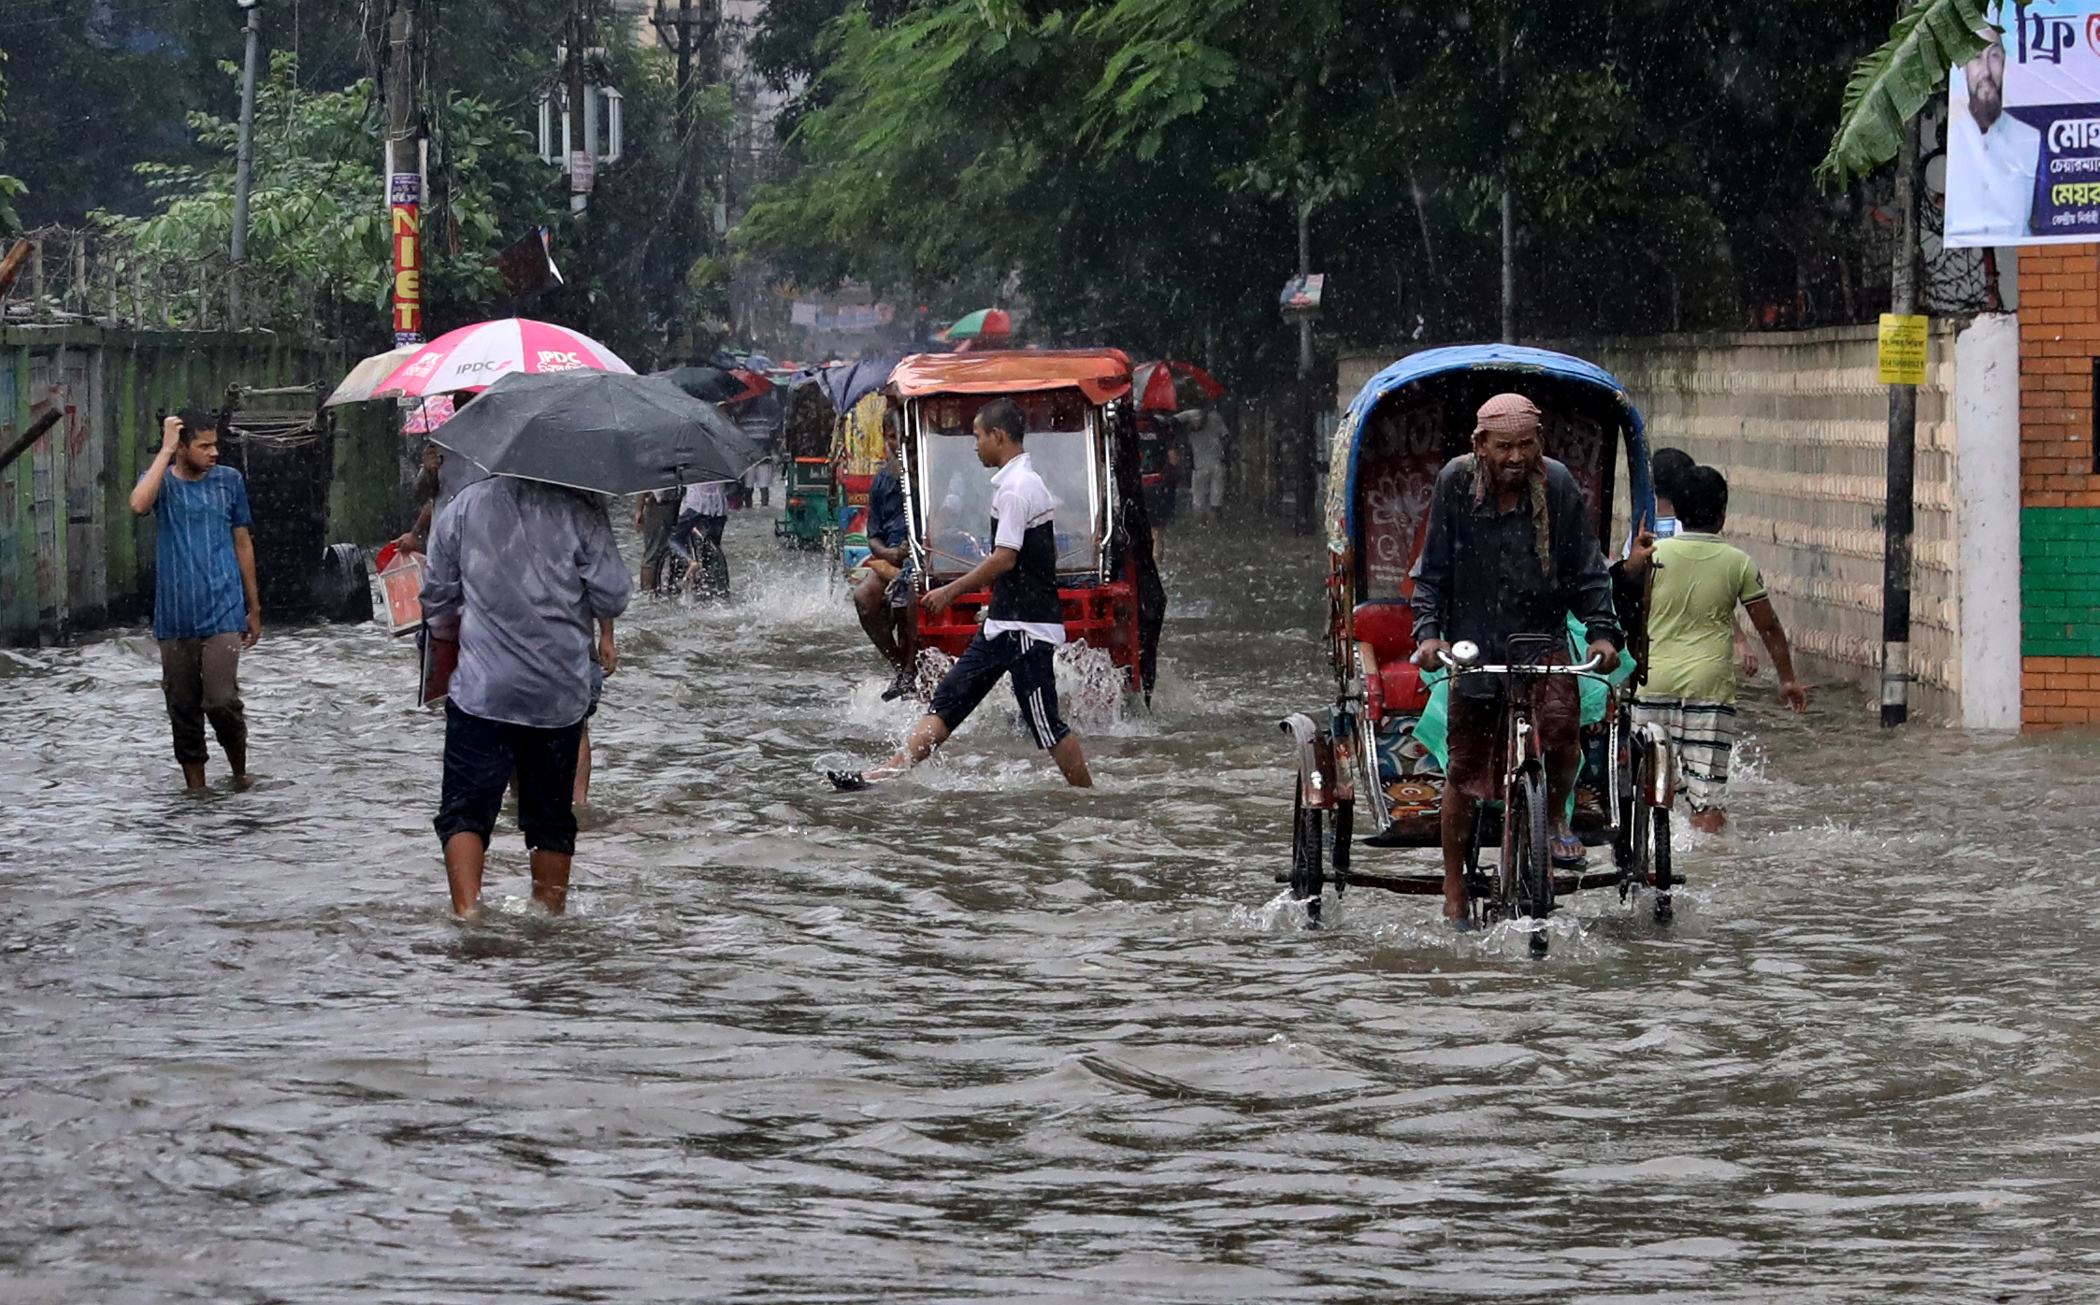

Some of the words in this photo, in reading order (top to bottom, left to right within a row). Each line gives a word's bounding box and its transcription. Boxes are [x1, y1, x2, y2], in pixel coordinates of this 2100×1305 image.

[392, 207, 420, 329] NIET
[537, 350, 581, 364] IPDC
[456, 361, 495, 375] IPDC
